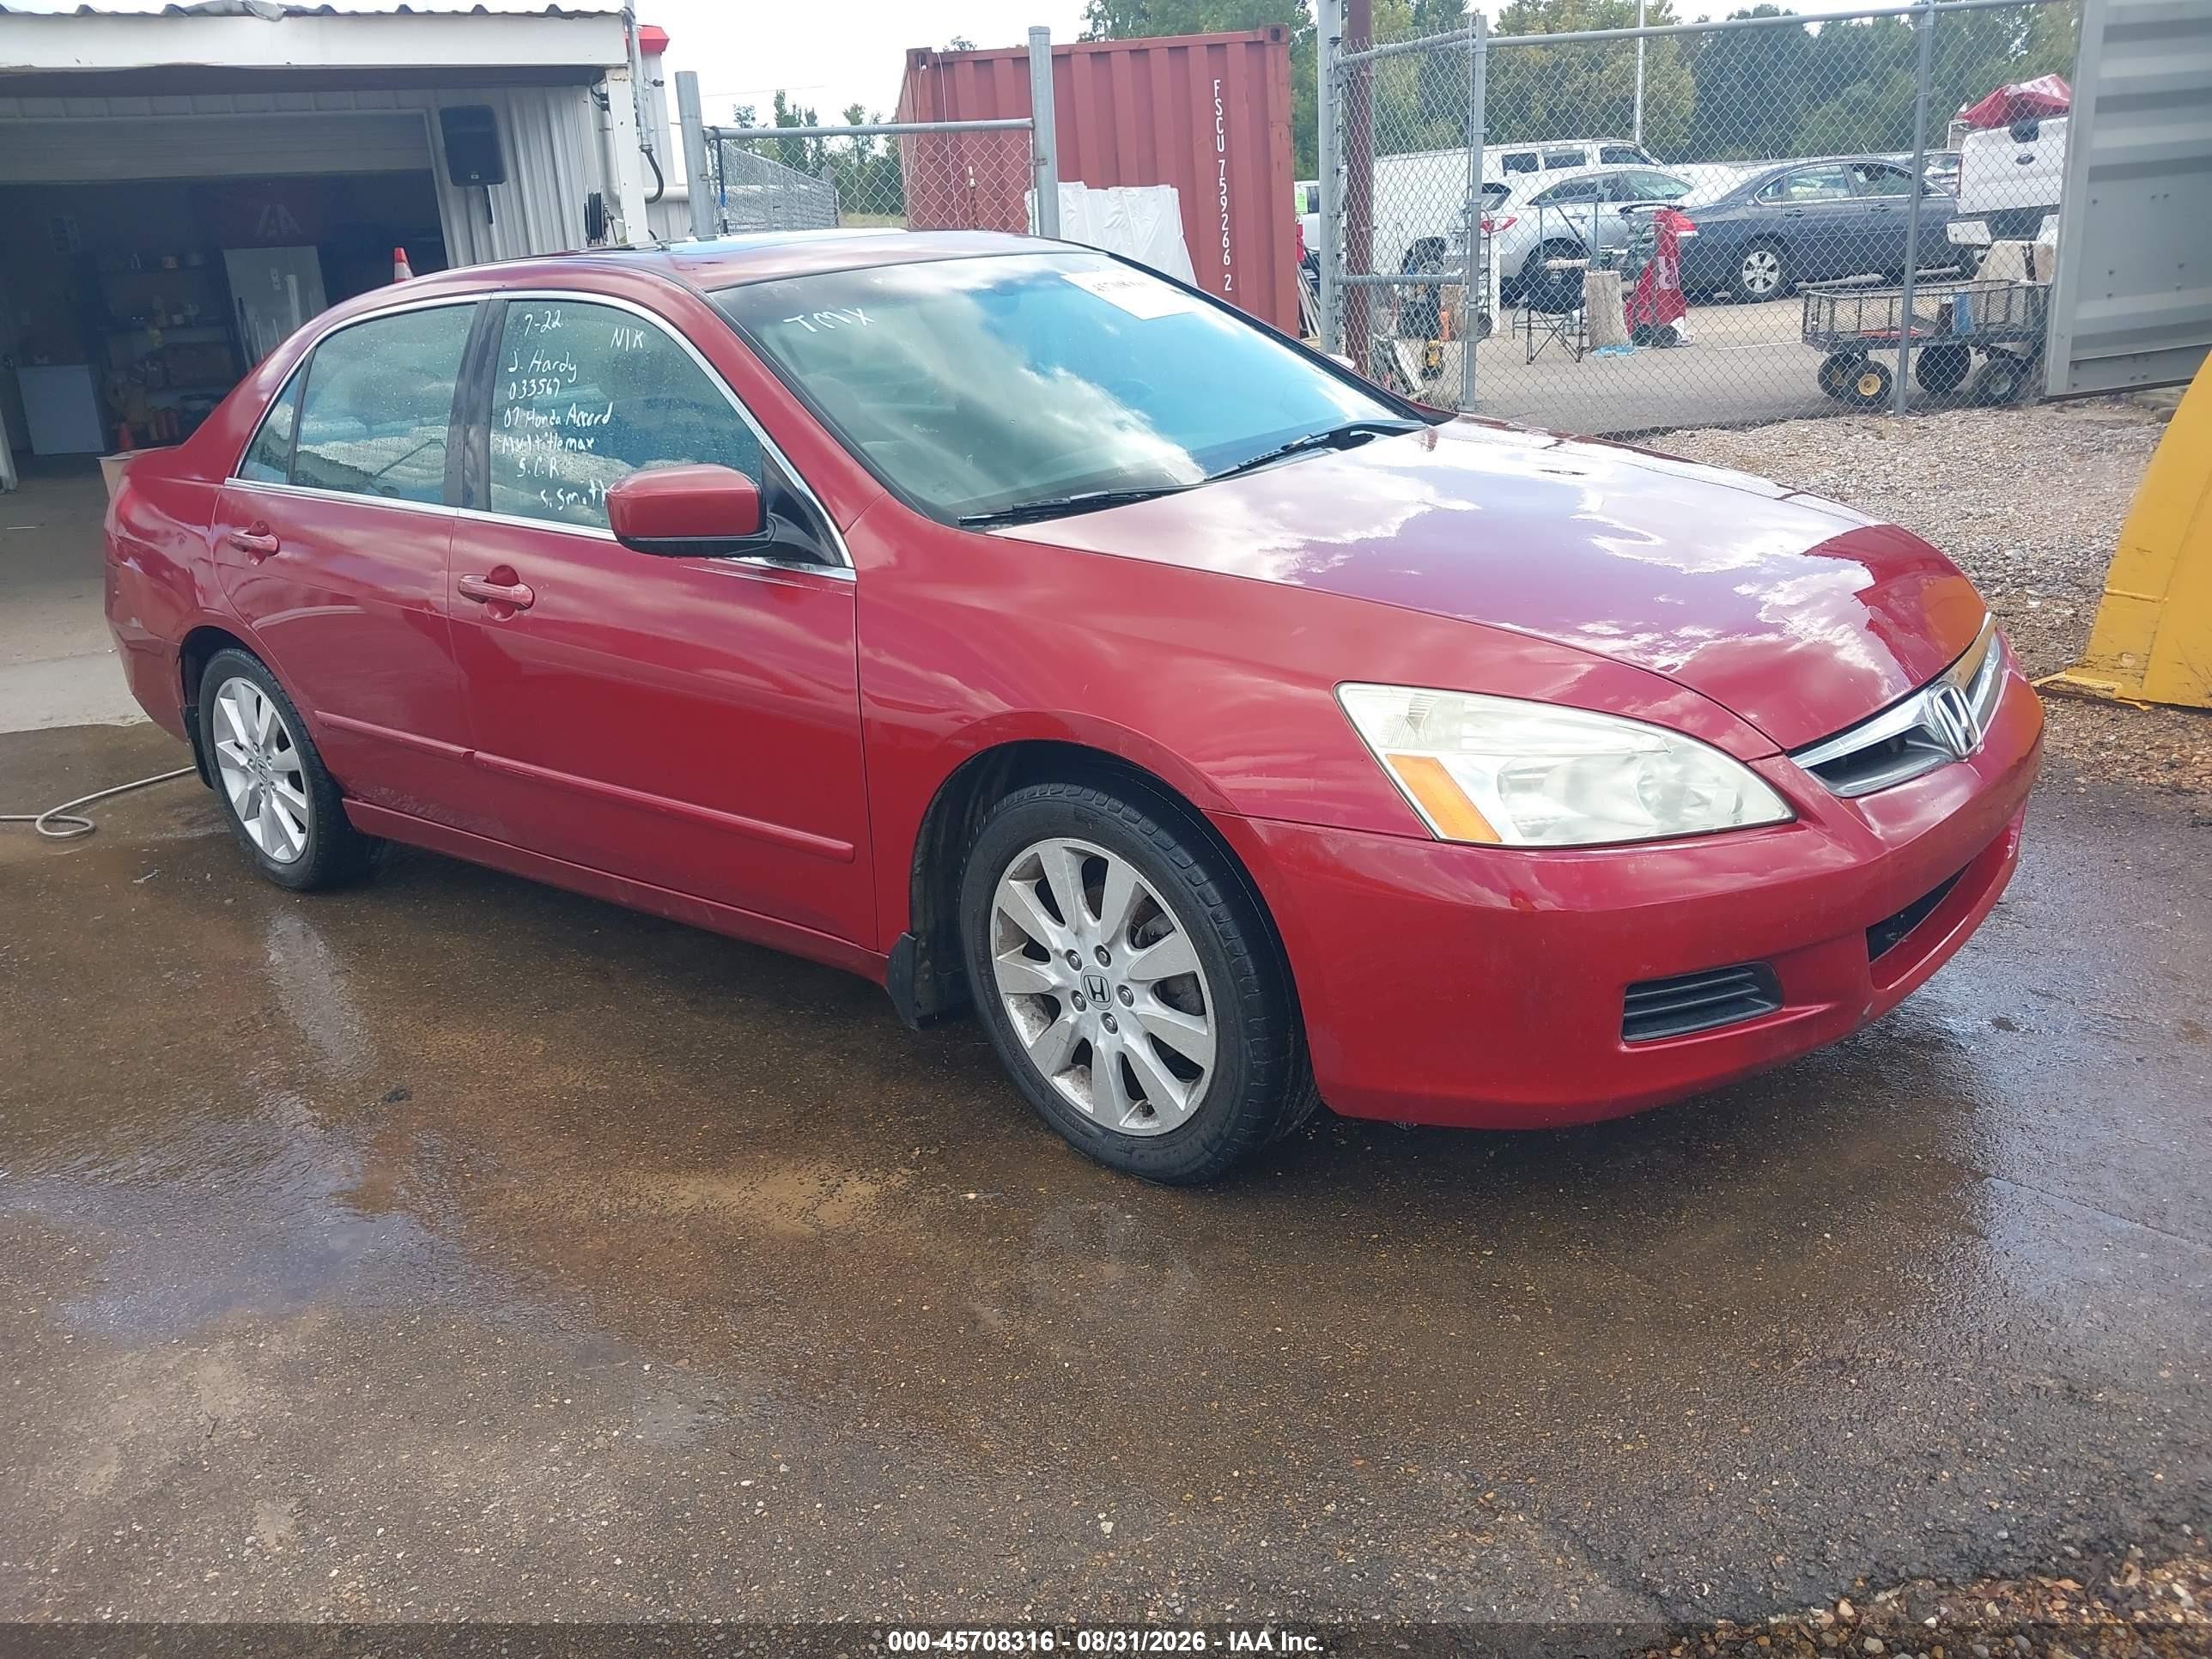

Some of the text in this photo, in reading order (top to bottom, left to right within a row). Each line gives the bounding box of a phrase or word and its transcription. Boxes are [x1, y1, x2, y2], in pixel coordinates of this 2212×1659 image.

[1213, 79, 1232, 292] FSCU 759266 2
[782, 307, 875, 333] TMX
[508, 349, 577, 383] J. Hardy
[509, 378, 560, 400] 033567
[526, 408, 562, 428] Honda
